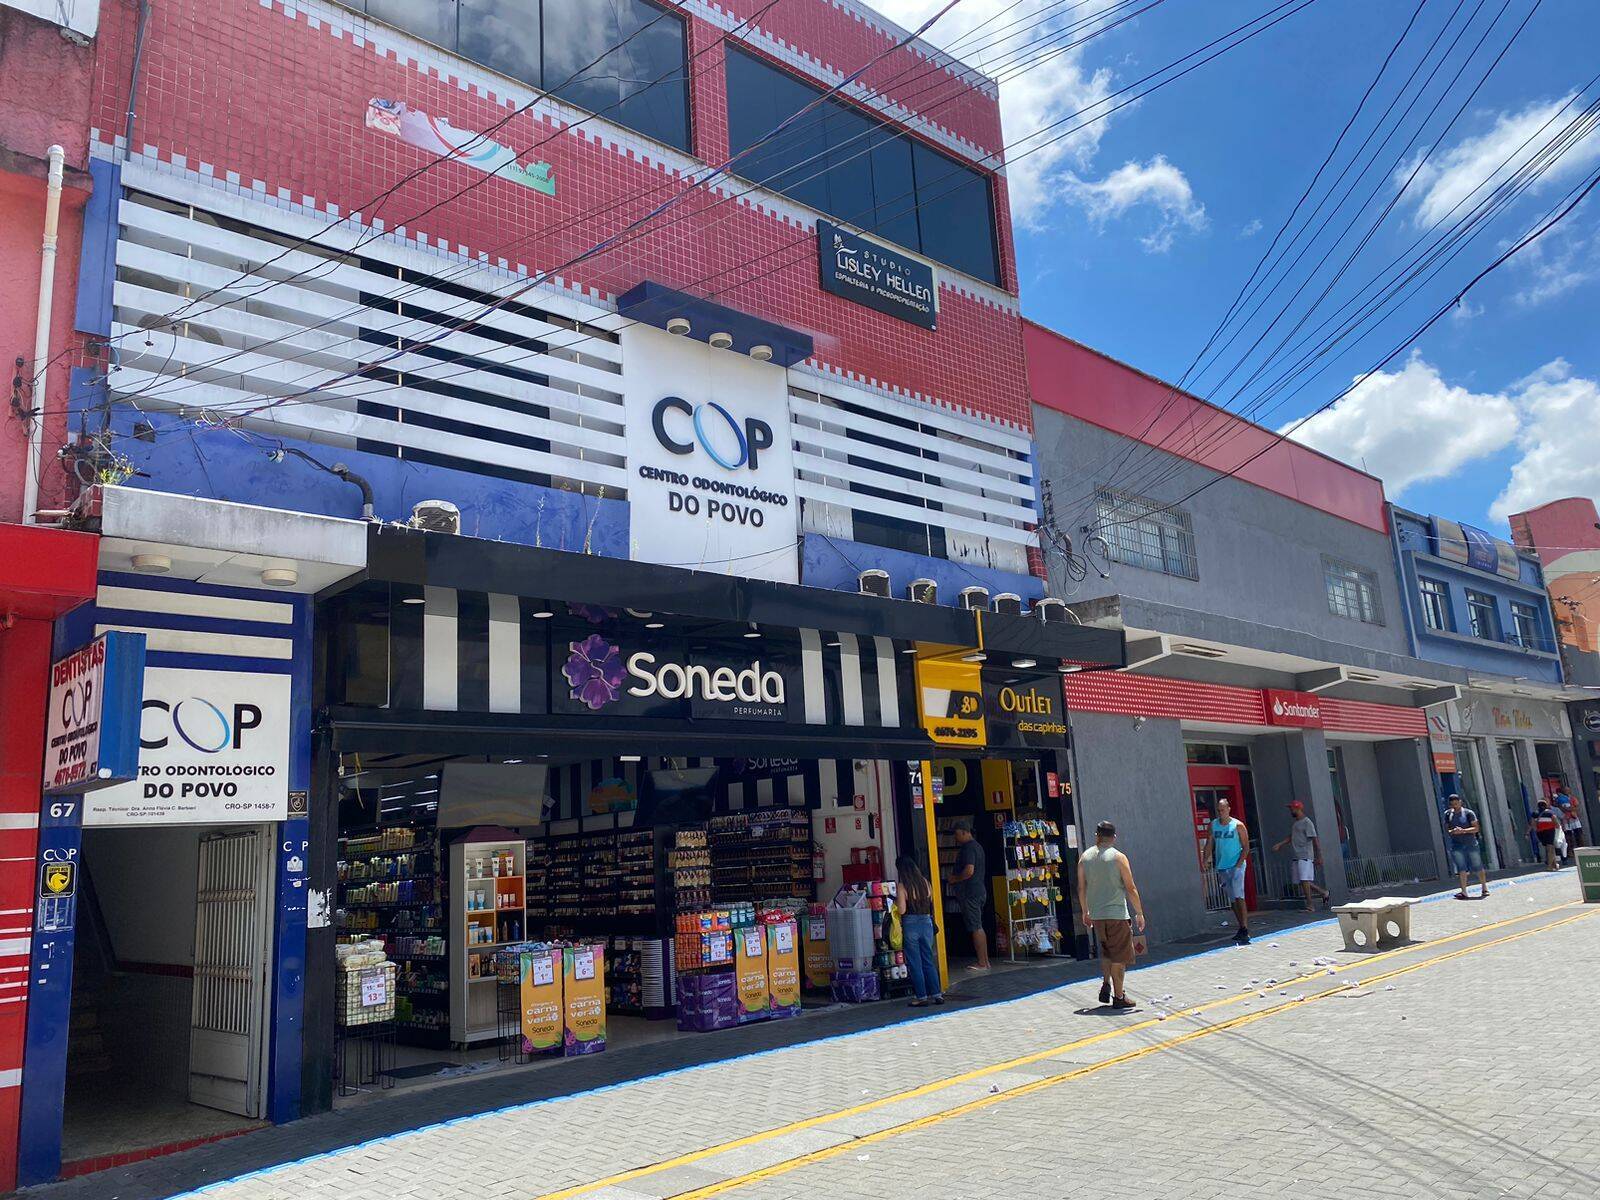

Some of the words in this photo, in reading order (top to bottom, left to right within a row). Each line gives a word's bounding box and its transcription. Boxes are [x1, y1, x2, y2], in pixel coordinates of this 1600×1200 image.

[835, 247, 882, 282] LISLEY
[864, 251, 911, 275] STUDIO
[652, 396, 773, 470] COP
[639, 466, 689, 486] CENTRO
[692, 476, 788, 506] ODONTOLÓGICO
[669, 491, 700, 515] DO
[707, 499, 764, 528] POVO
[53, 641, 104, 687] DENTISTAS
[627, 652, 785, 704] Soneda
[734, 707, 783, 717] PERFUMARIA
[1283, 701, 1320, 719] Santander
[1018, 720, 1033, 732] das
[1033, 722, 1067, 736] capinhas
[59, 746, 69, 765] DO
[165, 763, 276, 777] ODONTOLÓGICO
[909, 772, 922, 784] 71
[143, 783, 175, 799] DO
[180, 781, 238, 798] POVO
[1060, 782, 1072, 795] 75
[50, 803, 75, 818] 67
[224, 803, 253, 811] CRO-SP
[254, 802, 276, 810] 1458-7
